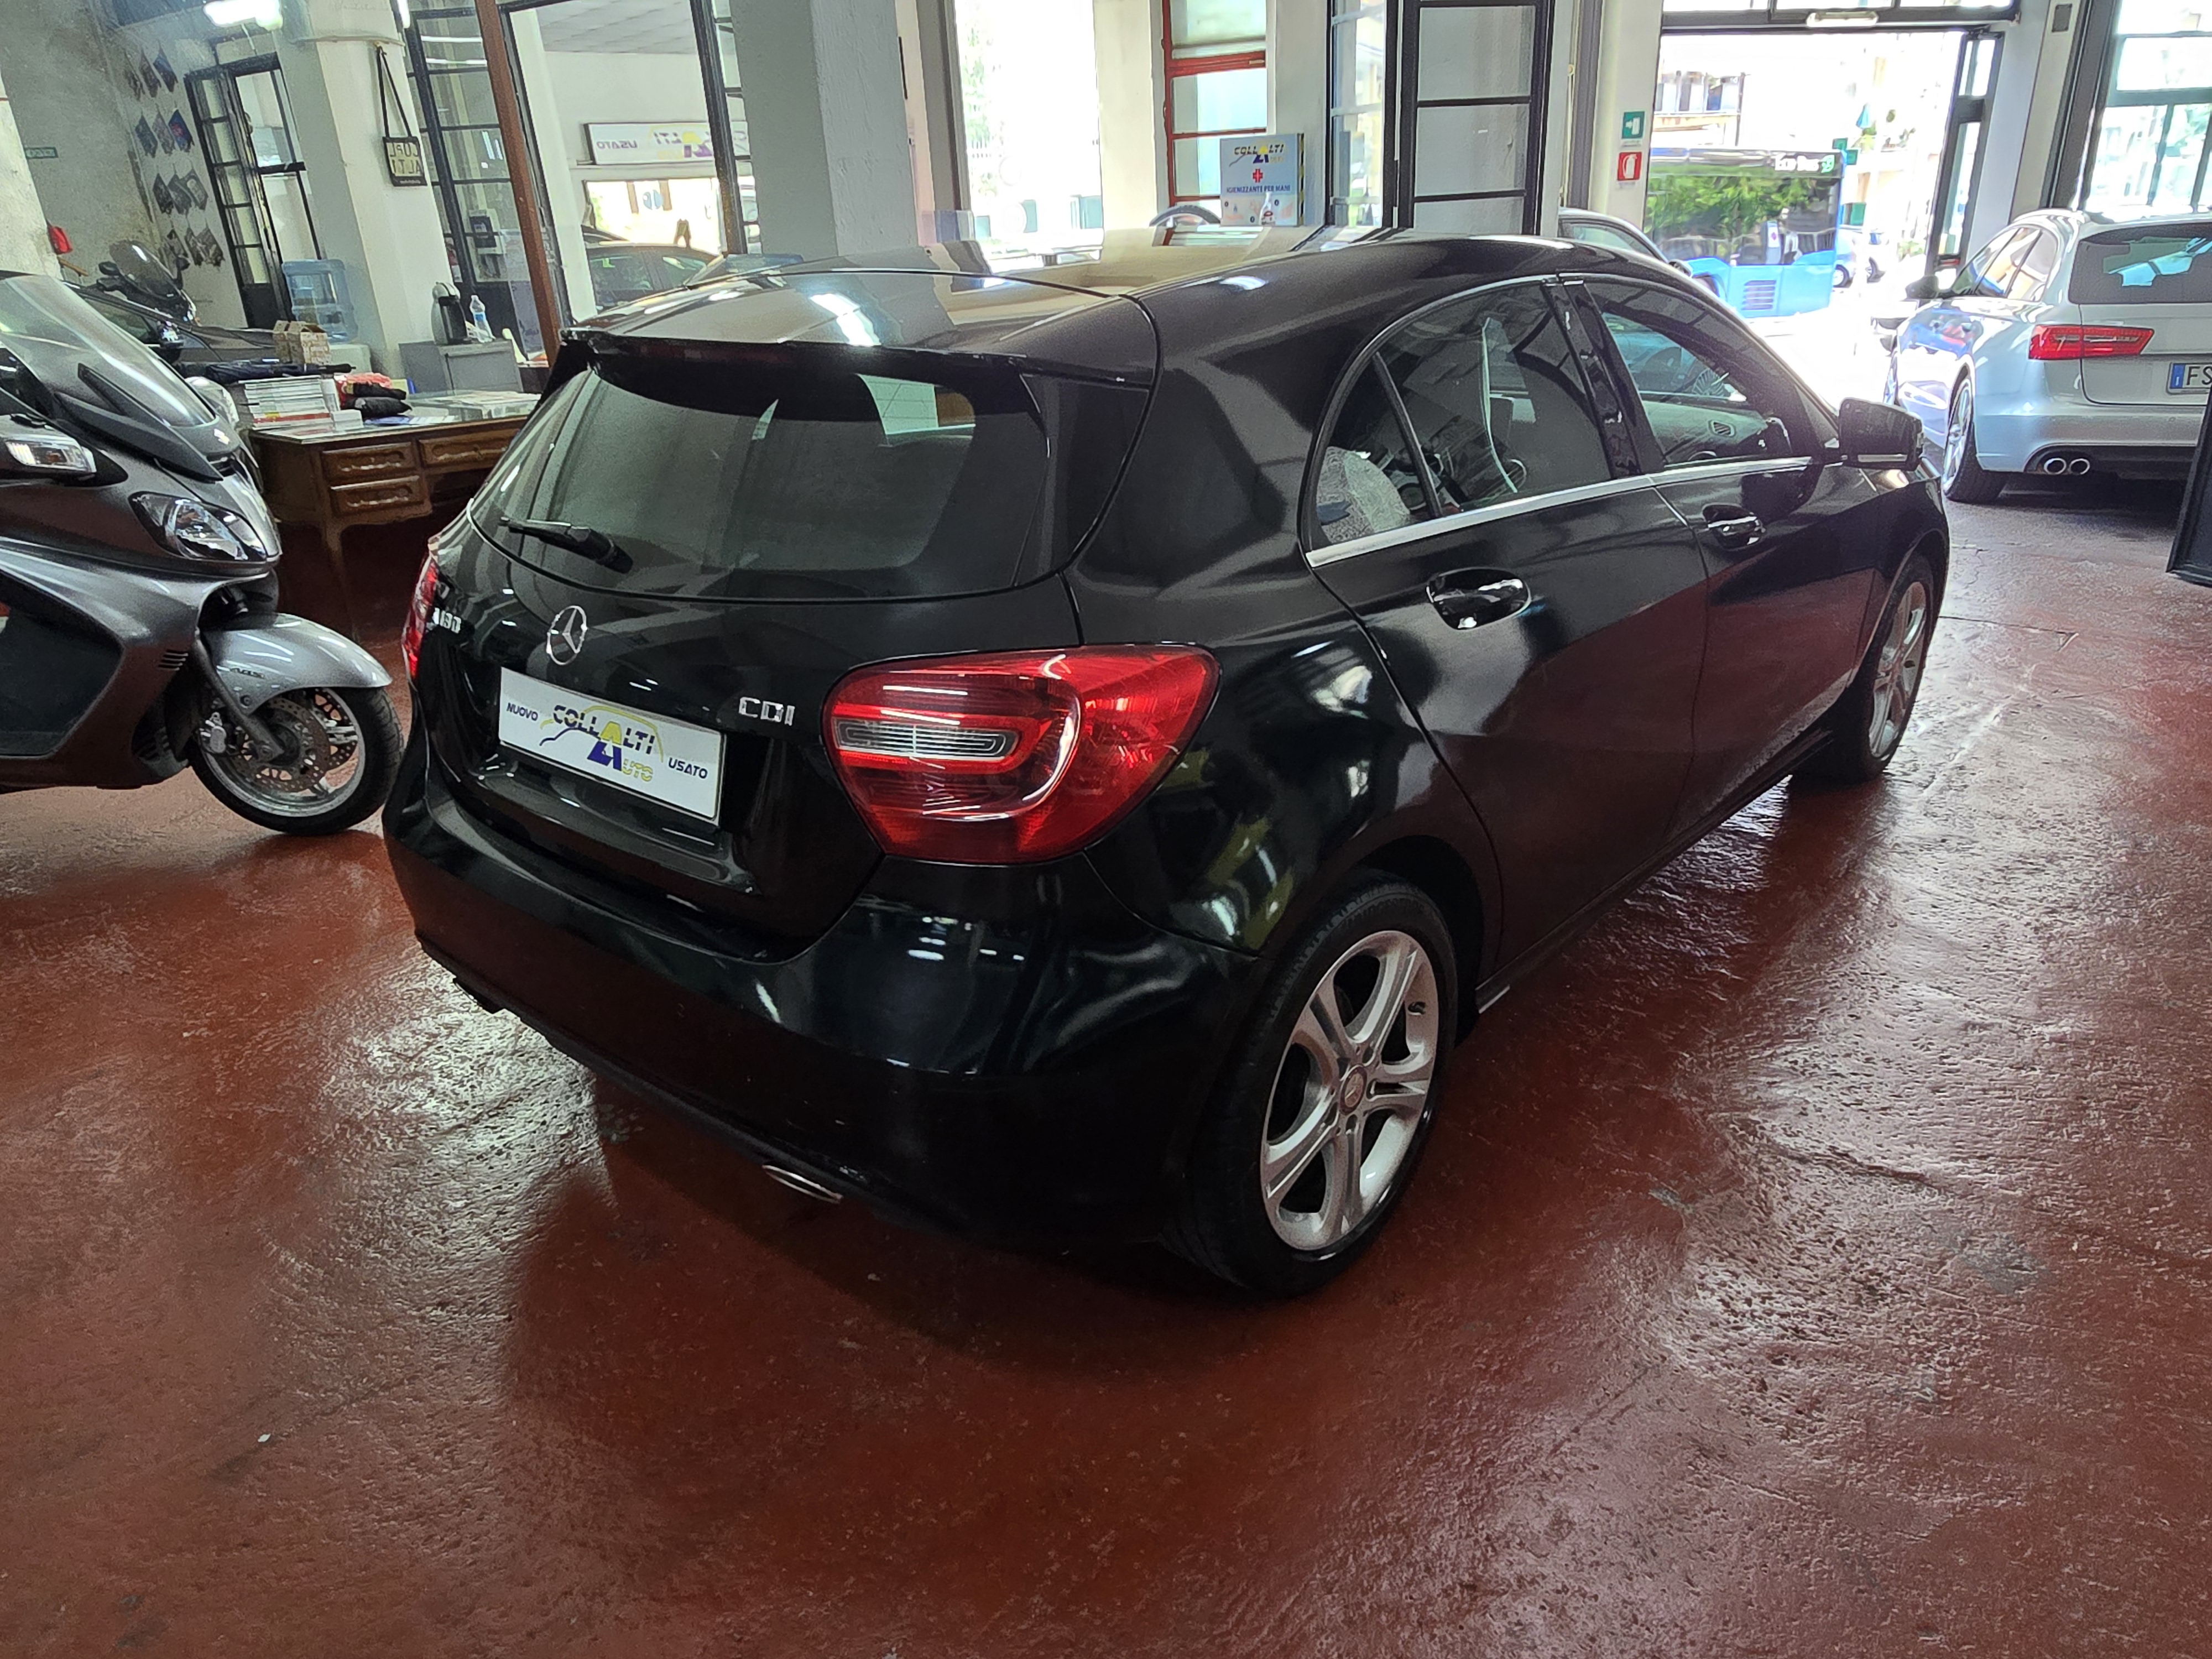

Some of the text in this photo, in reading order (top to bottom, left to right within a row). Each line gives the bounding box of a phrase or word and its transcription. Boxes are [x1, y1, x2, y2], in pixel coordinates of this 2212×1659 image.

[2186, 366, 2212, 385] FS
[506, 702, 539, 721] NUOVO
[738, 697, 795, 727] CDI
[668, 757, 708, 779] USATO
